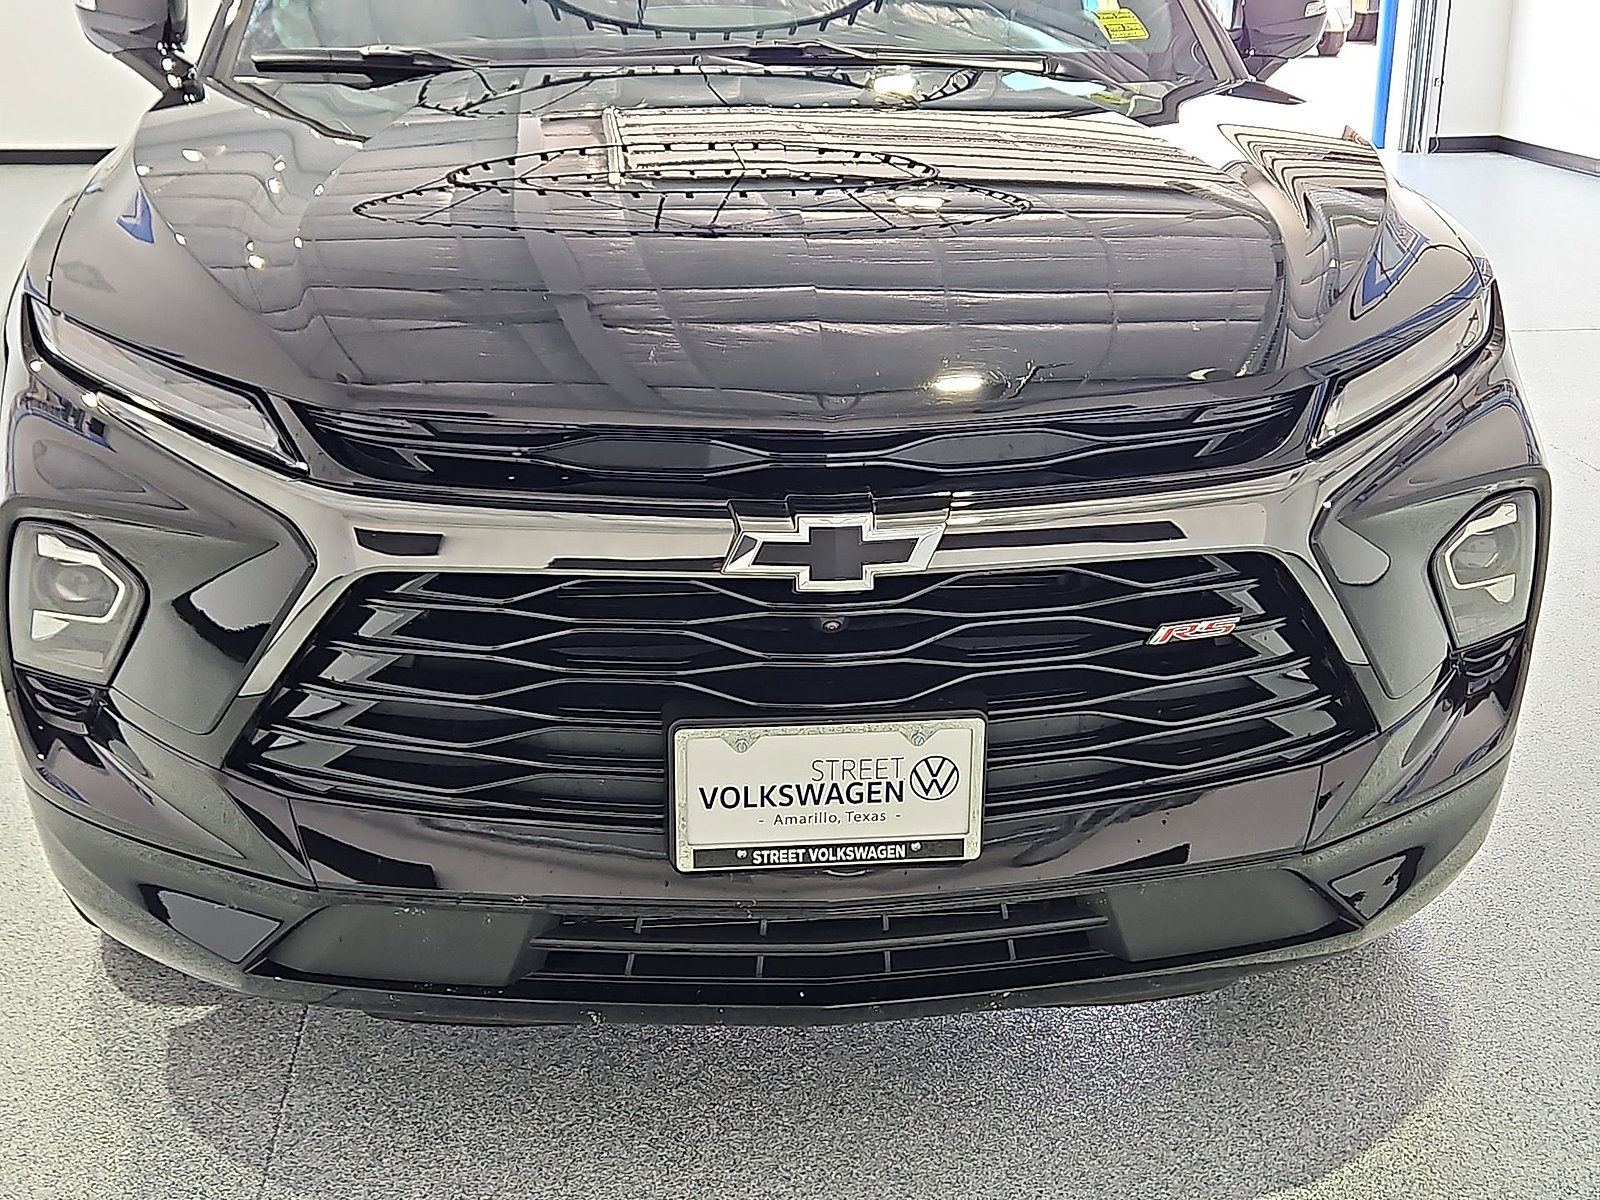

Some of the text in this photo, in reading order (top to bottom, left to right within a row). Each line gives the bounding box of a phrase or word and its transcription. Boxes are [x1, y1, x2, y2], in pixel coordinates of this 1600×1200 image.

[1149, 617, 1241, 645] RS
[811, 757, 904, 782] STREET
[699, 780, 904, 810] VOLKSWAGEN
[773, 812, 842, 826] Amarillo,
[846, 811, 886, 823] Texas
[752, 844, 905, 864] STREET VOLKSWAGEN
